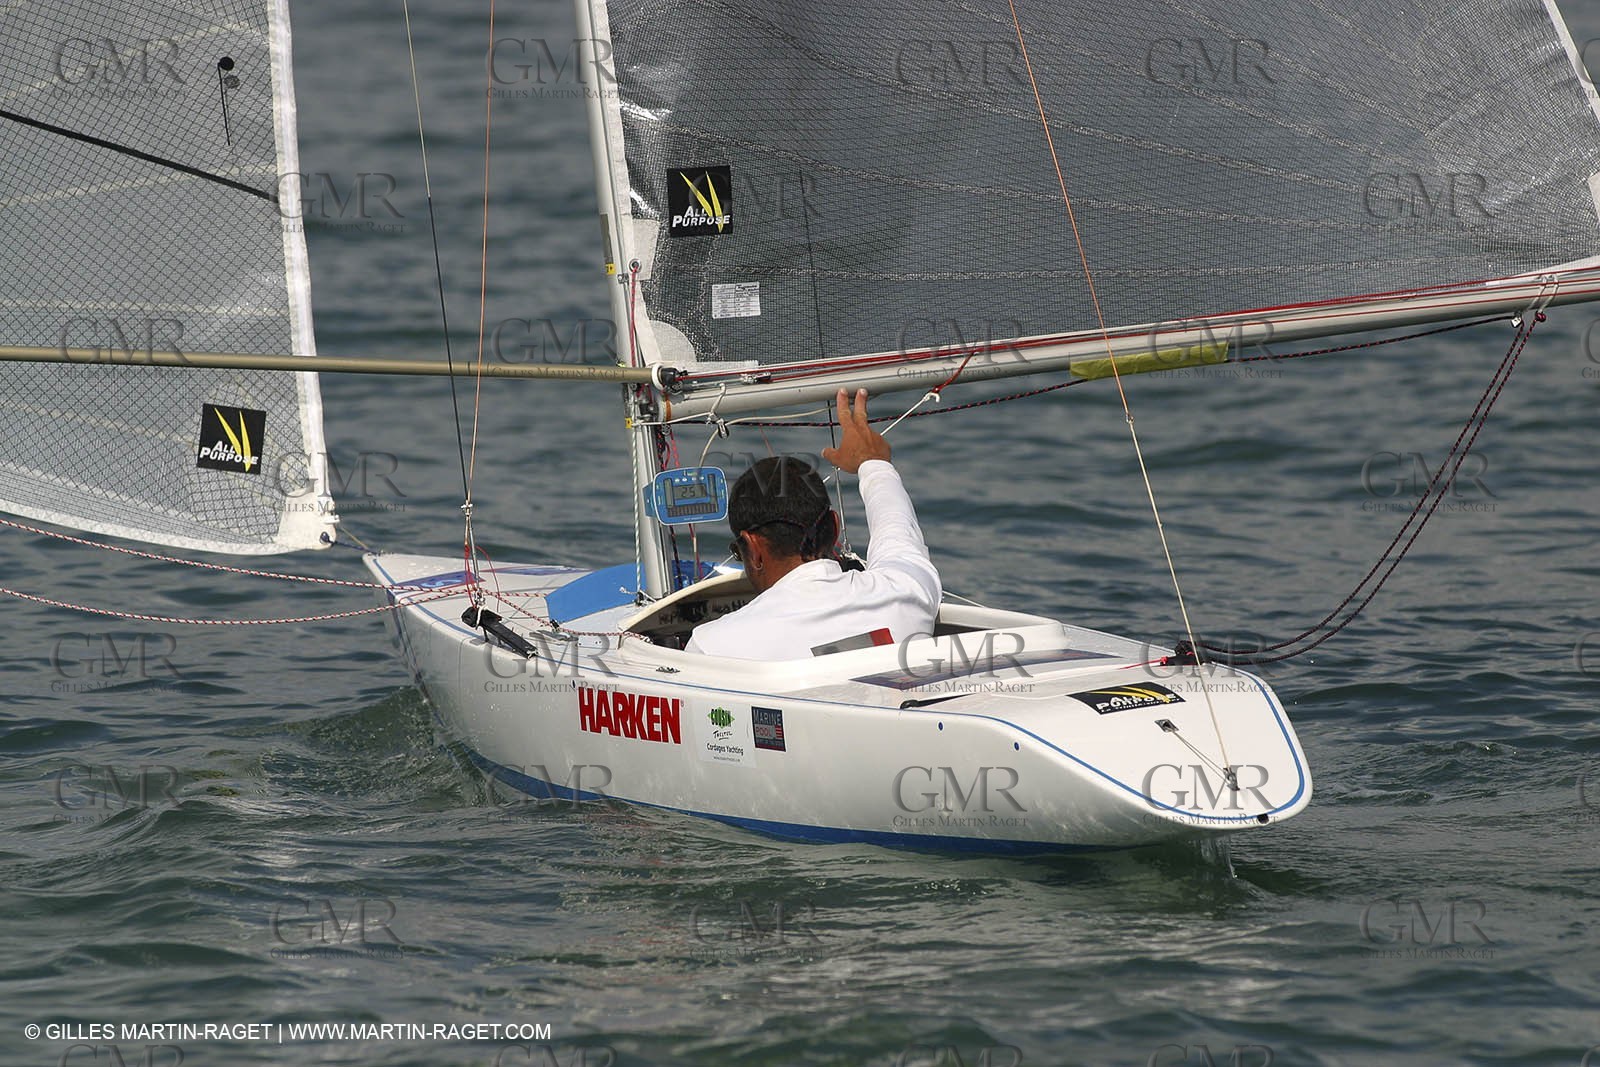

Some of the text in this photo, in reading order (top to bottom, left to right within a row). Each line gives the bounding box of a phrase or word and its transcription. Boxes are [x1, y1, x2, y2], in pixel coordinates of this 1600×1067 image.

[684, 205, 708, 217] ALL
[672, 214, 731, 228] PURPOSE
[212, 440, 236, 454] ALL
[199, 446, 259, 465] PURPOSE
[578, 682, 682, 745] HARKEN
[753, 709, 782, 726] MARINE
[706, 742, 744, 756] Cordages Yachting
